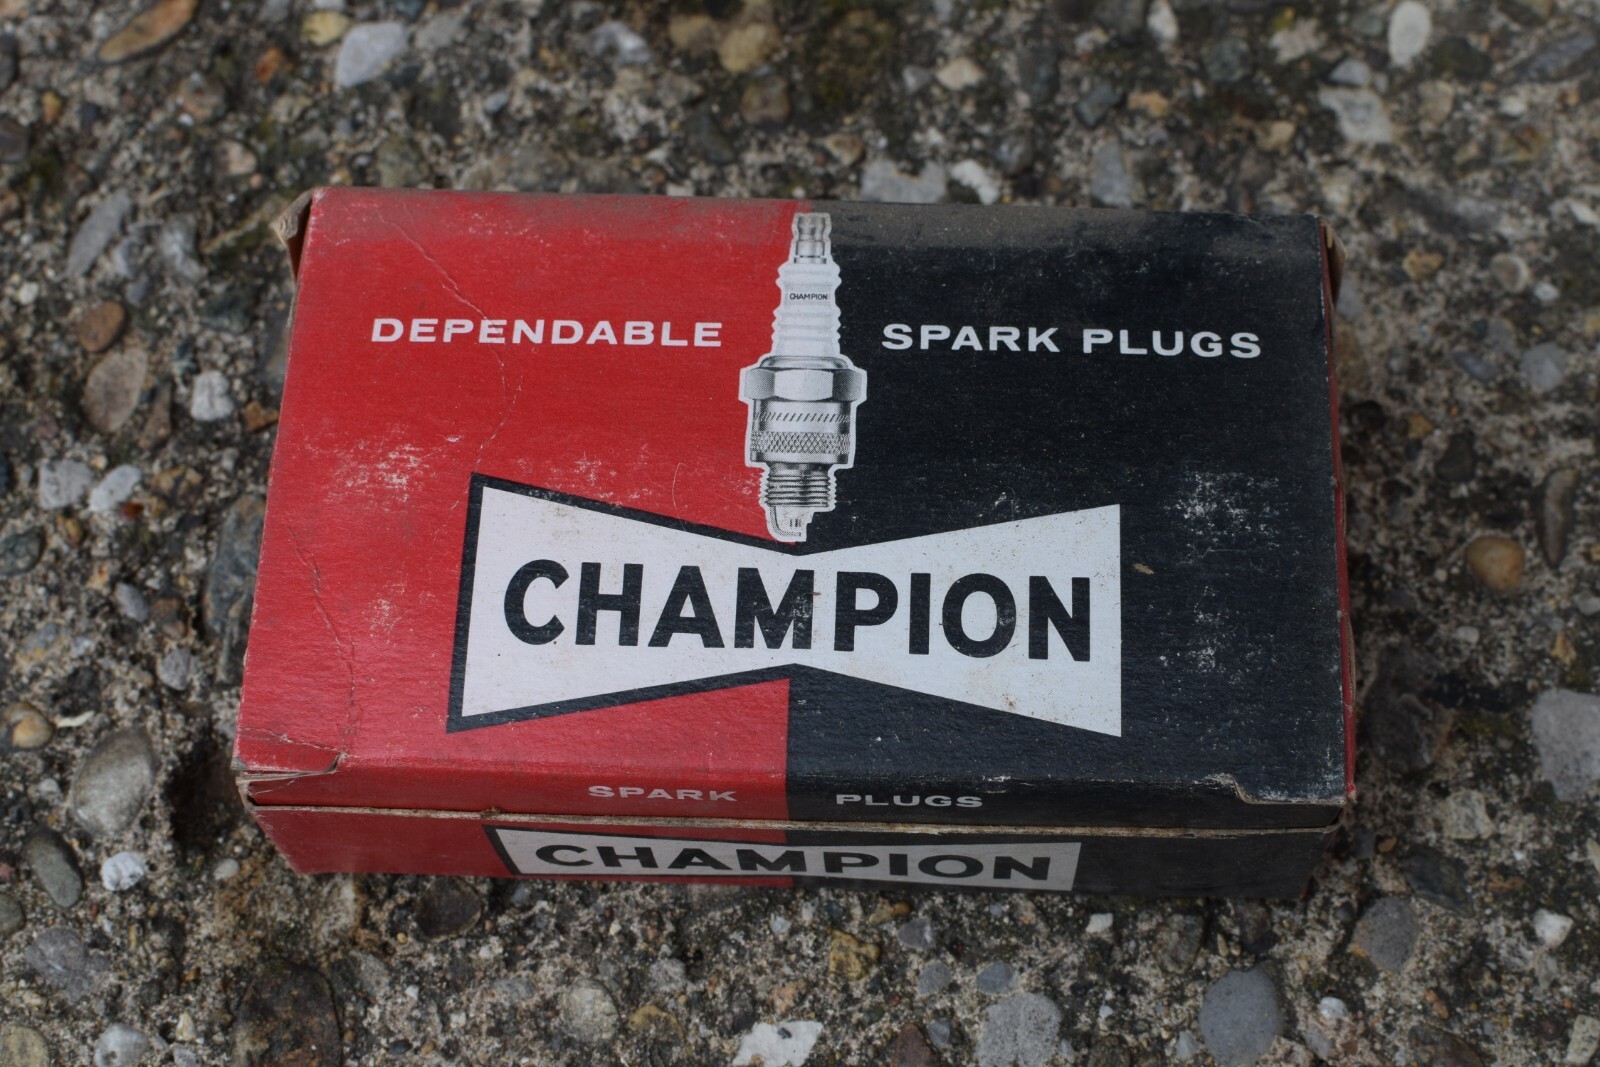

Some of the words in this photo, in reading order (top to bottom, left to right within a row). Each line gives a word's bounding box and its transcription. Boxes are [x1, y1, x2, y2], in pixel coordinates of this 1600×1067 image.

[789, 292, 828, 301] CHAMPION
[371, 318, 723, 348] DEPENDABLE
[881, 323, 1061, 353] SPARK
[1082, 328, 1262, 359] PLUGS
[503, 559, 1091, 662] CHAMPION
[588, 785, 738, 803] SPARK
[835, 793, 984, 808] PLUGS
[535, 843, 1052, 882] CHAMPION
